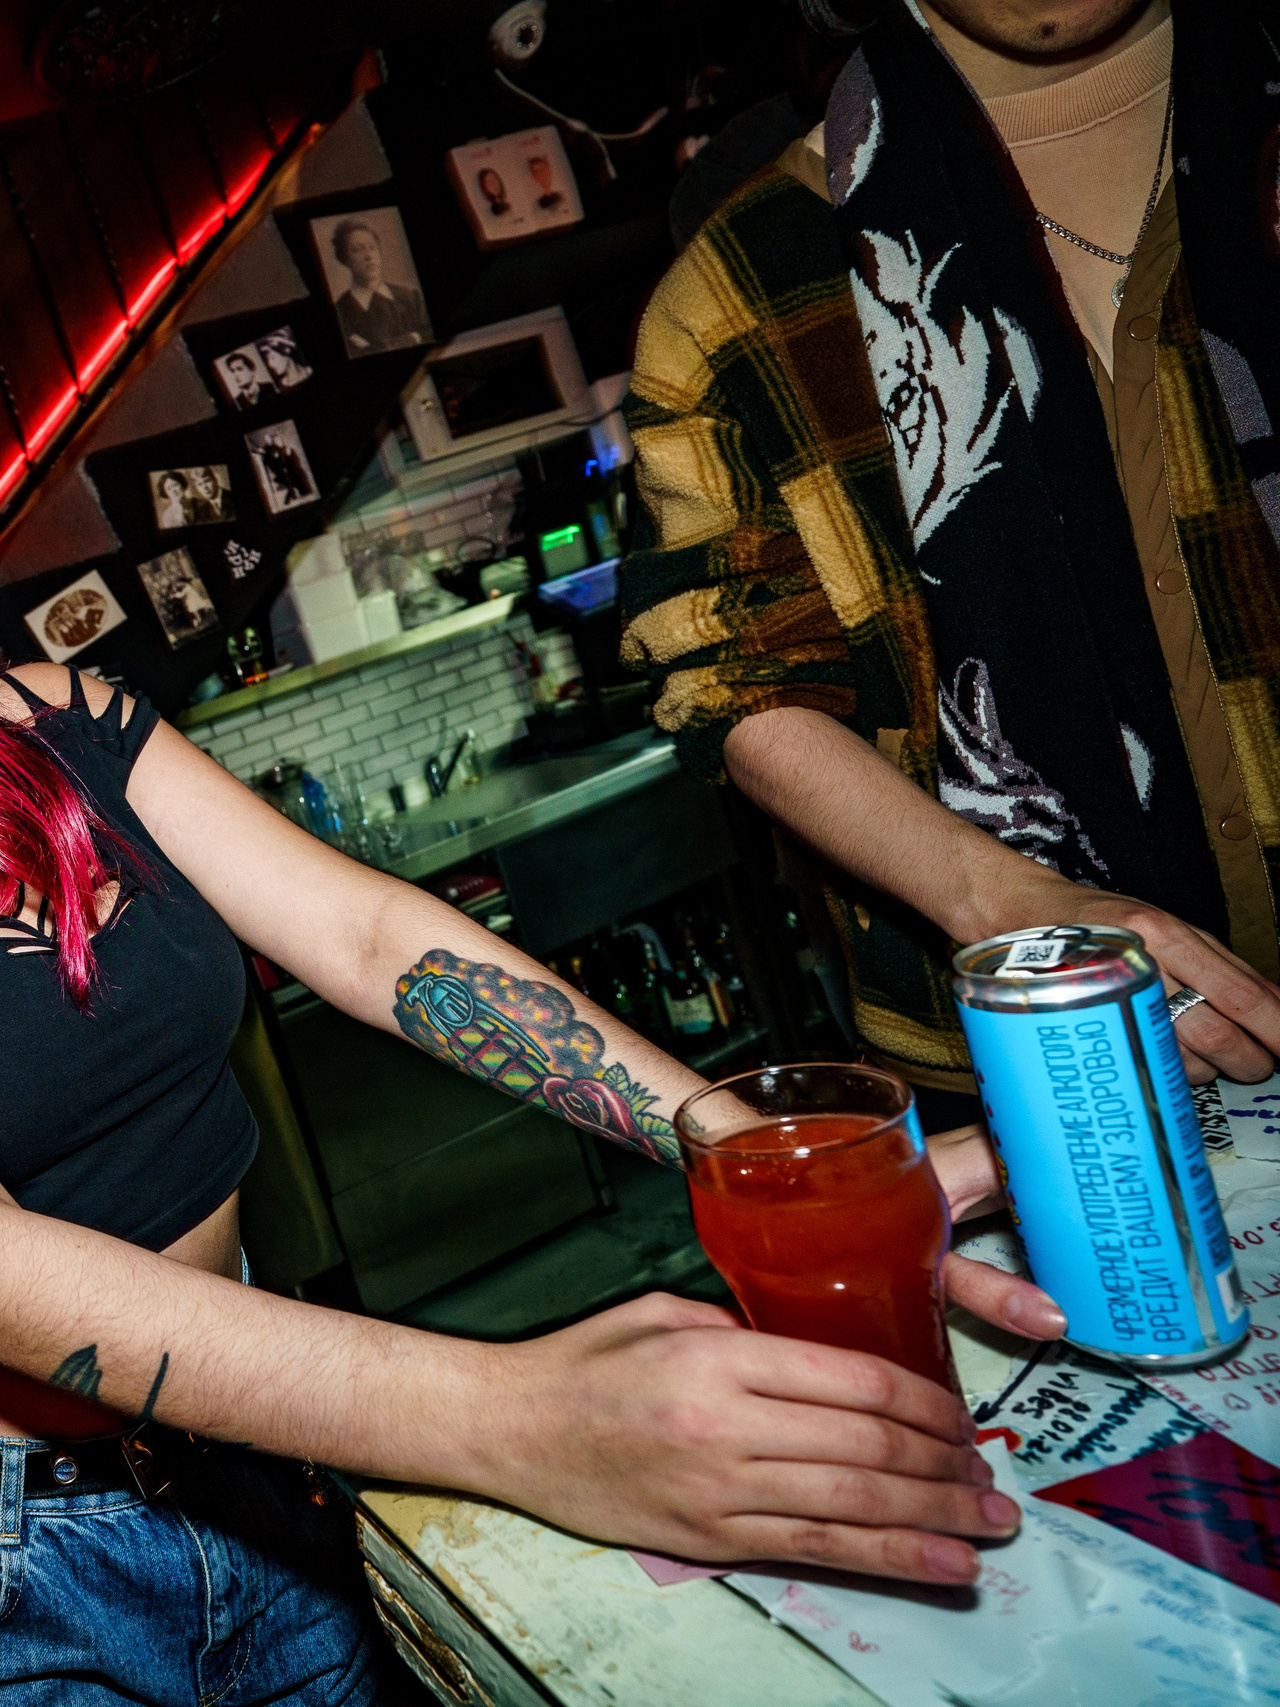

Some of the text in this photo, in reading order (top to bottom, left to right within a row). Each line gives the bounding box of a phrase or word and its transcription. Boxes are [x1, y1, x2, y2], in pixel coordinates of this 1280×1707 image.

[1036, 1025, 1089, 1112] АЛКОГОЛЯ
[1074, 1020, 1138, 1146] ЗДОРОВЬЮ
[1059, 1115, 1121, 1236] УПОТРЕБЛЕНИЕ
[1107, 1152, 1161, 1248] ВАШЕМУ
[1091, 1238, 1146, 1341] ЧРЕЗМЕРНОЕ
[1134, 1257, 1186, 1342] ВРЕДИТ
